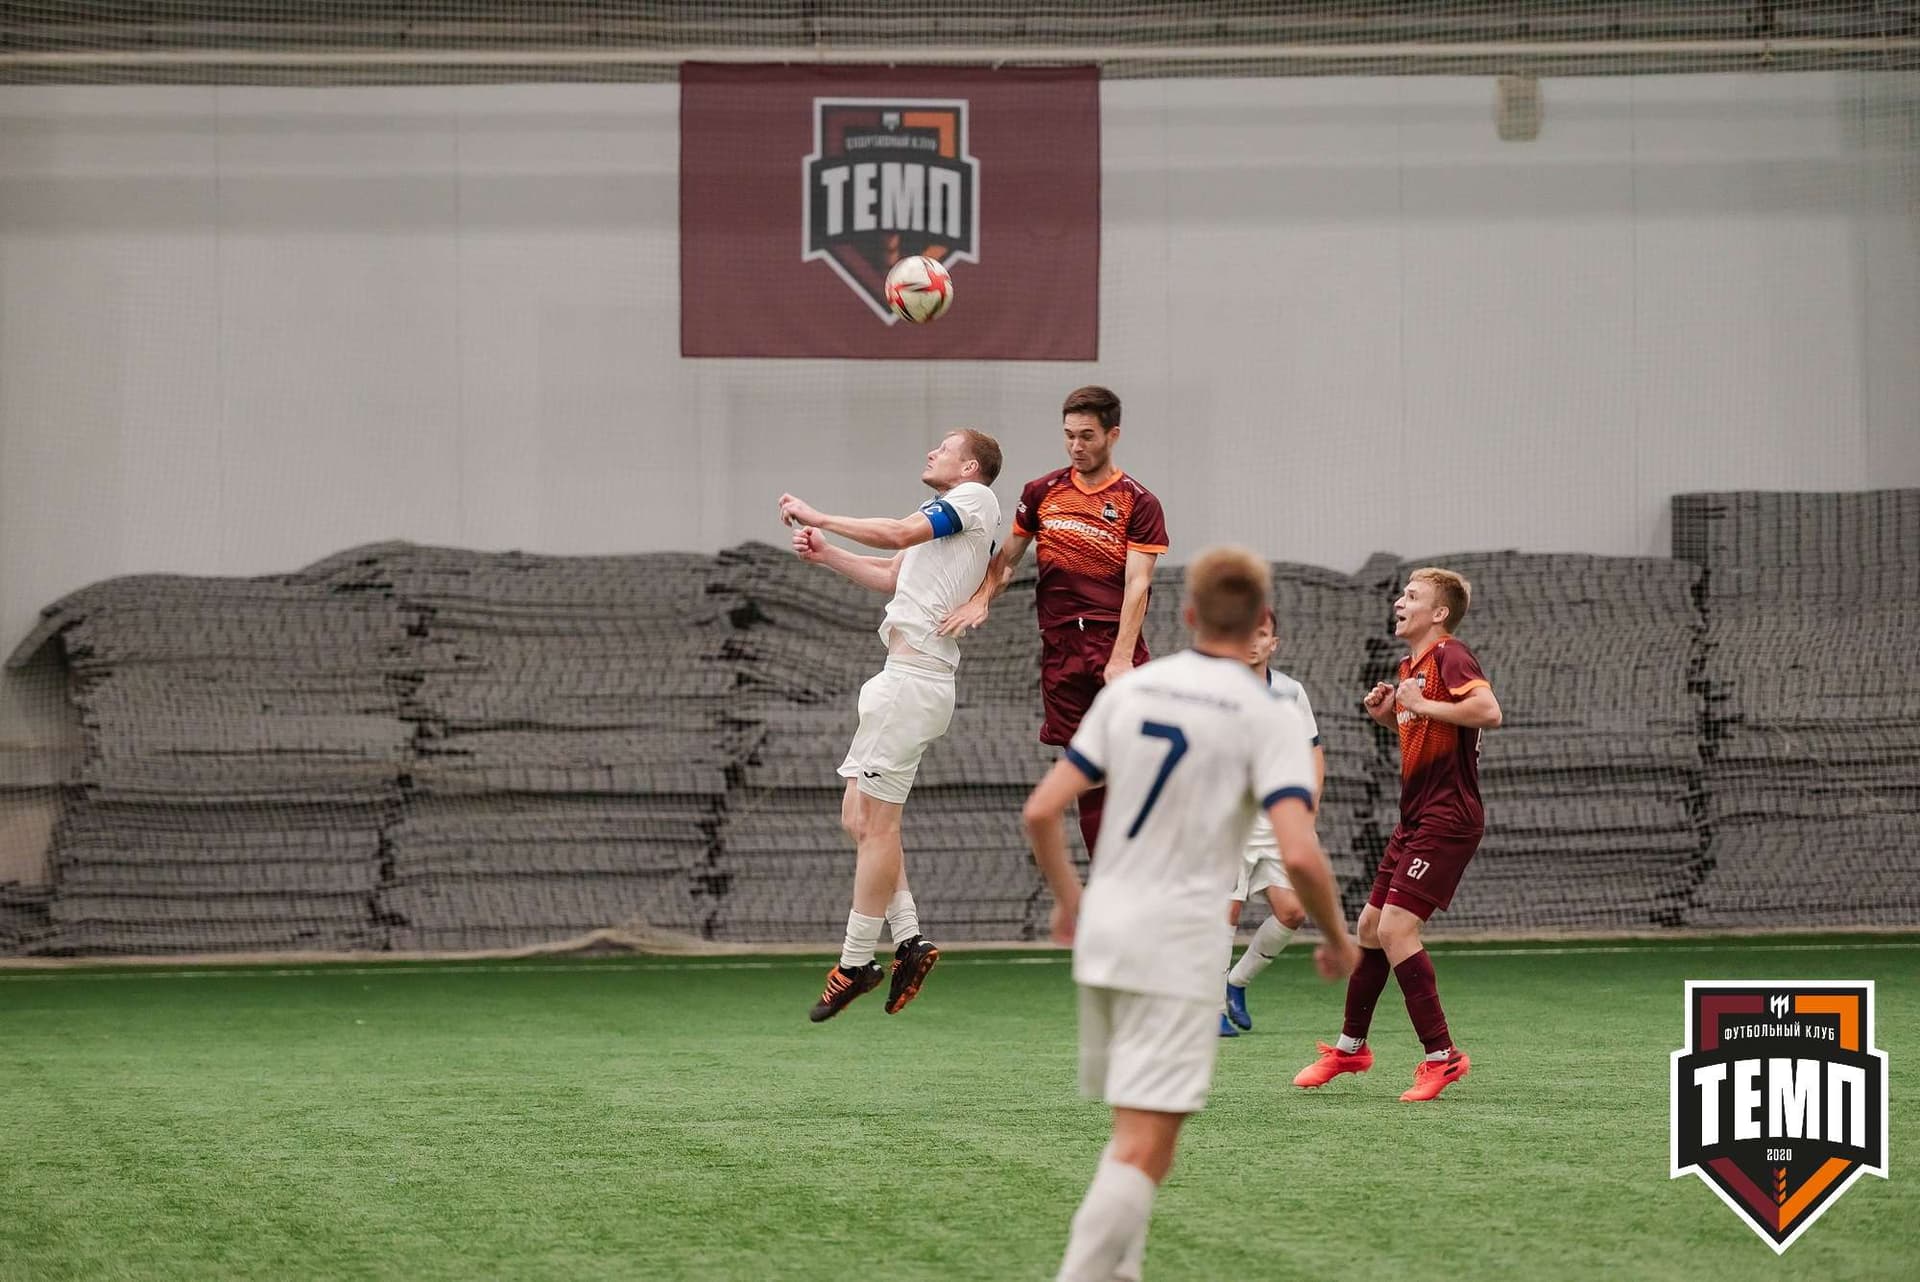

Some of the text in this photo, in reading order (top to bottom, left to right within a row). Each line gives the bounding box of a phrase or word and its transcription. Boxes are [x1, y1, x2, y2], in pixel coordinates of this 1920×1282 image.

[820, 162, 962, 239] ТЕМП
[1126, 720, 1189, 840] 7
[1406, 857, 1431, 880] 27
